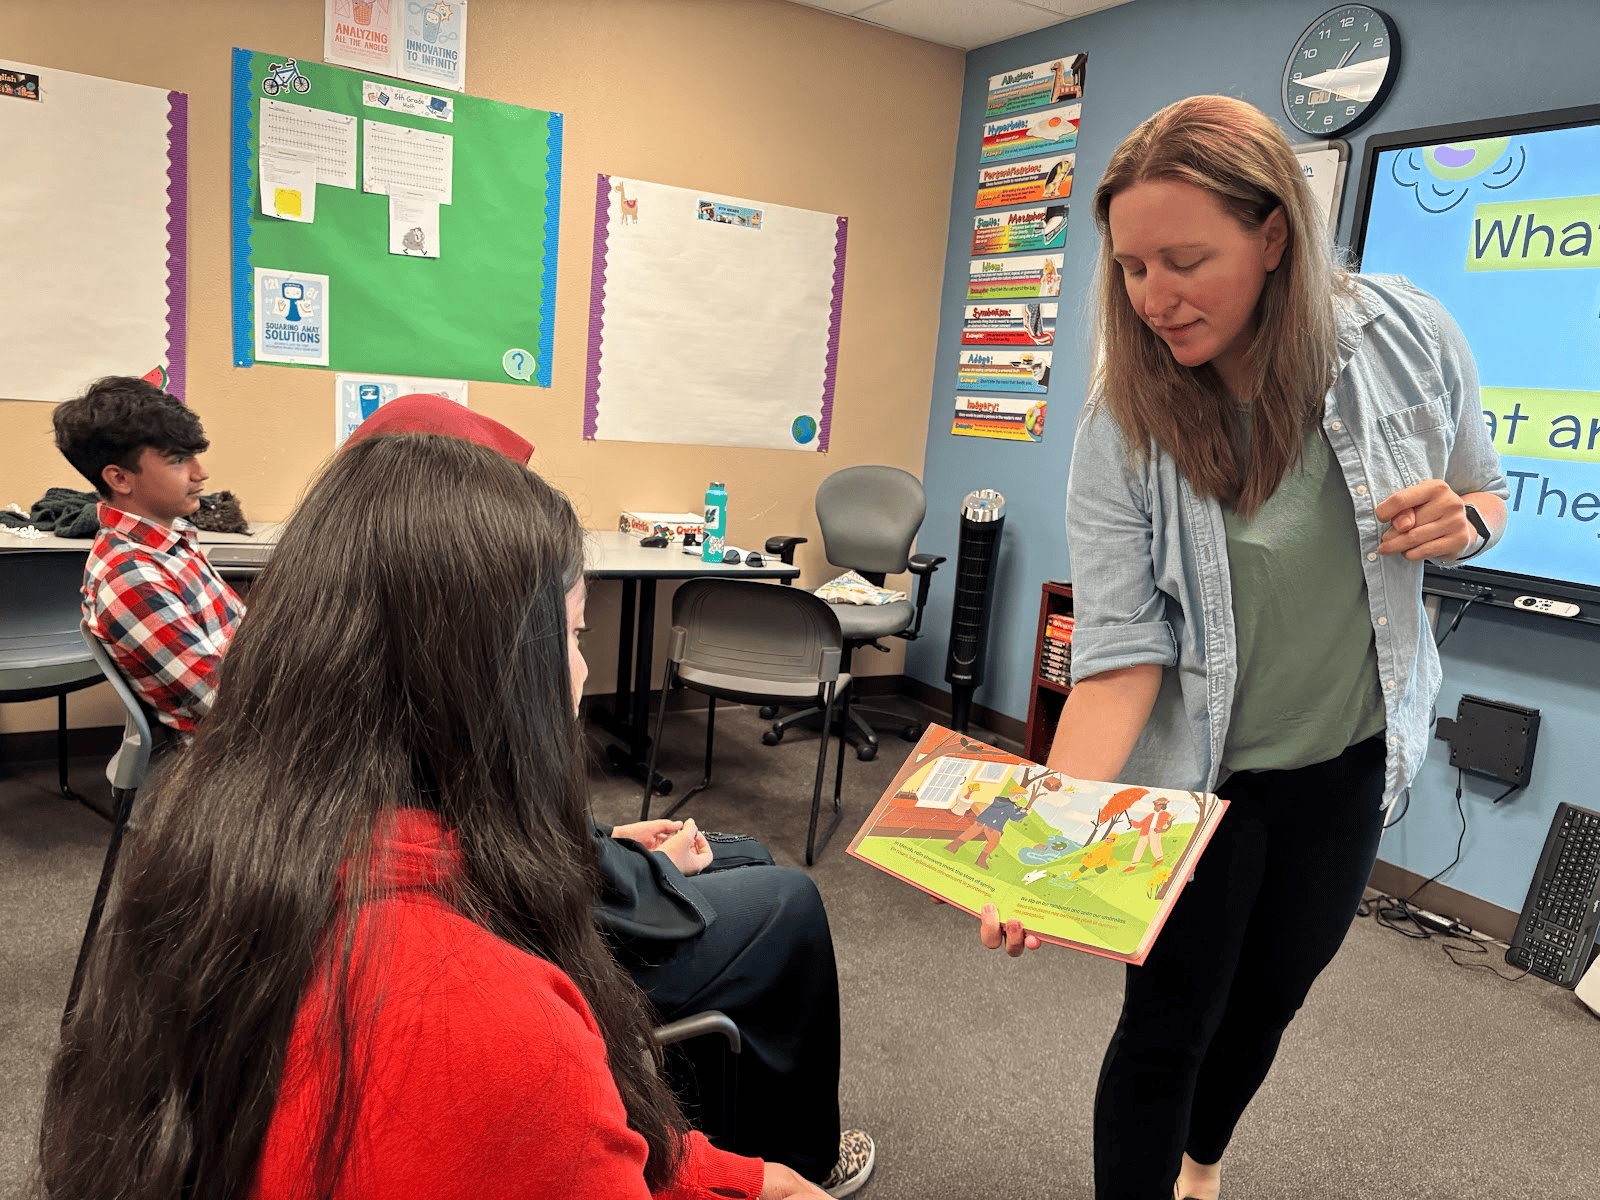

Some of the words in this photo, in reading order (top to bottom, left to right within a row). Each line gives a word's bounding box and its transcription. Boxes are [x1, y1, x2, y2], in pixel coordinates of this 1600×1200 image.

[1340, 17, 1354, 28] 12
[1363, 22, 1369, 32] 1
[336, 23, 388, 44] ANALYZING
[1319, 29, 1331, 40] 11
[334, 34, 346, 43] ALL
[350, 38, 361, 47] THE
[364, 42, 388, 53] ANGLES
[1373, 38, 1384, 48] 2
[406, 40, 458, 60] INNOVATING
[1303, 48, 1318, 59] 10
[407, 50, 418, 62] TO
[422, 54, 457, 70] INFINITY
[1001, 70, 1034, 86] Allusion:
[406, 96, 424, 104] Grade
[1295, 95, 1304, 104] 8
[1306, 110, 1315, 120] 7
[1346, 106, 1356, 116] 5
[1324, 116, 1333, 125] 6
[987, 120, 1028, 137] Hyperbole:
[983, 164, 1042, 180] Personification:
[976, 217, 1000, 229] Simile:
[1475, 214, 1600, 259] Wha
[982, 261, 1004, 272] Idiom:
[972, 307, 1011, 320] Symbolism:
[266, 322, 299, 331] SQUARING
[265, 329, 320, 343] SOLUTIONS
[968, 354, 993, 367] Adage:
[967, 399, 999, 413] Imagery:
[1506, 470, 1600, 538] The
